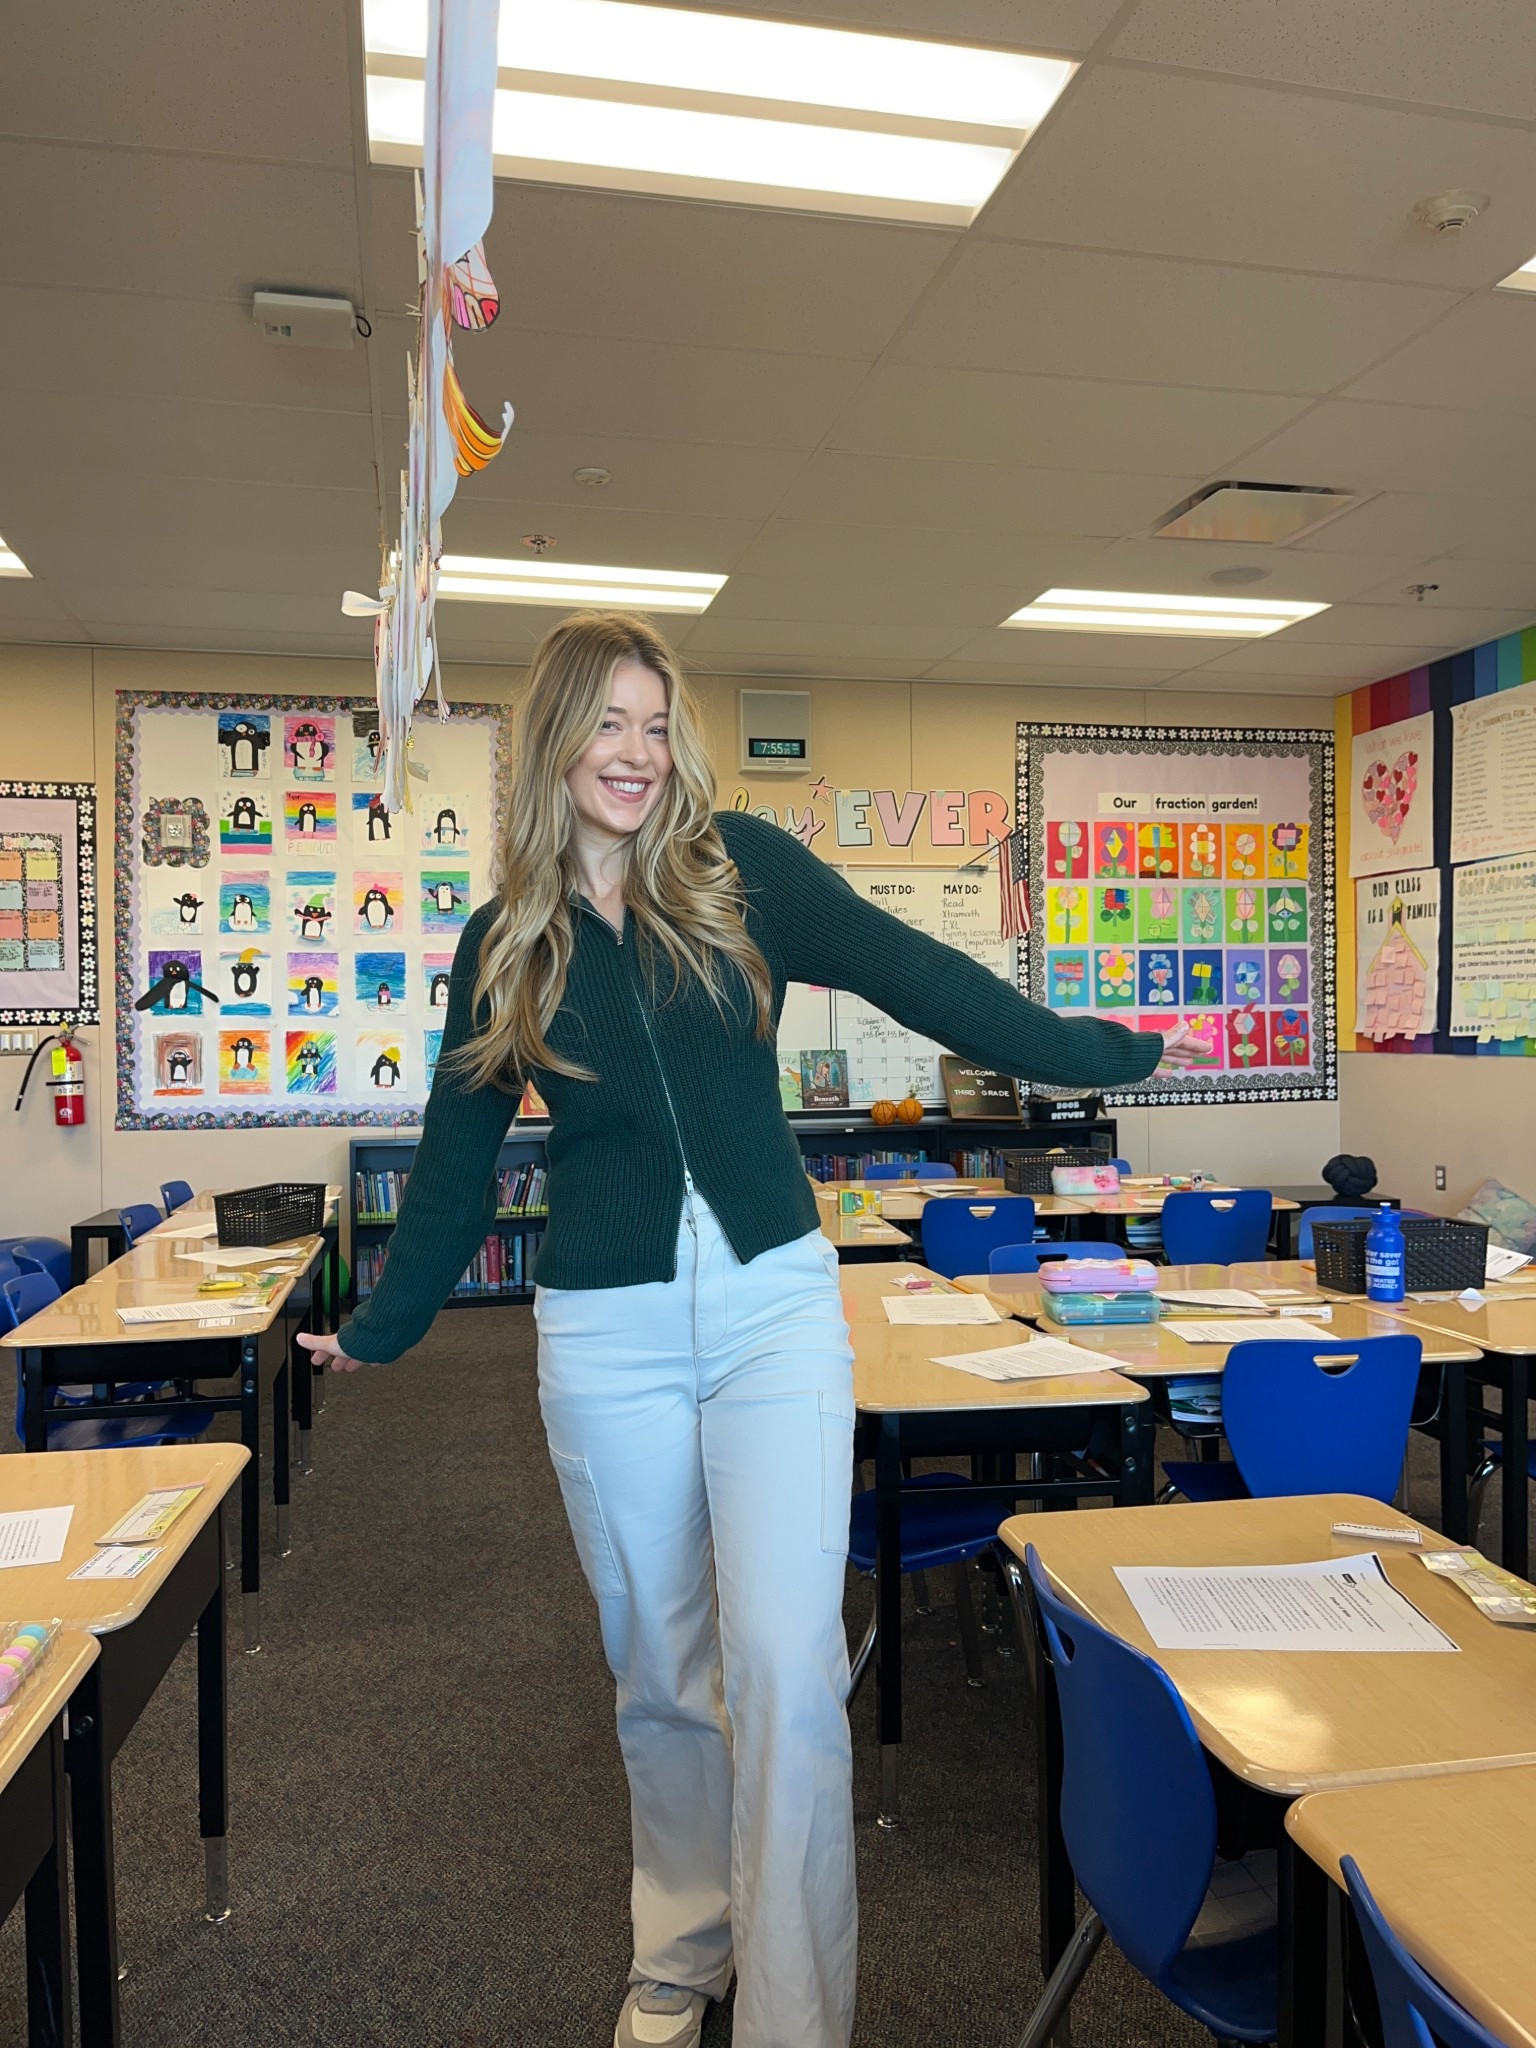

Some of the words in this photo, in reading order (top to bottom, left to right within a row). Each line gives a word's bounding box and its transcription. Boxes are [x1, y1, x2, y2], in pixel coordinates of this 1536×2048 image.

[761, 742, 784, 755] 7:55
[1113, 797, 1137, 808] Our
[1155, 797, 1206, 809] fraction
[1211, 798, 1258, 812] garden!
[834, 789, 1014, 847] EVER
[870, 884, 897, 895] MUST
[898, 884, 915, 895] DO:
[943, 884, 963, 895] MAY
[965, 885, 982, 895] DO:
[1372, 881, 1389, 898] OUR
[1395, 877, 1421, 895] CLASS
[1367, 909, 1376, 924] IS
[1378, 908, 1384, 923] A
[1406, 902, 1438, 920] FAMILY
[958, 1069, 998, 1077] WELCOME
[1370, 1257, 1383, 1265] the
[1385, 1259, 1400, 1267] go!
